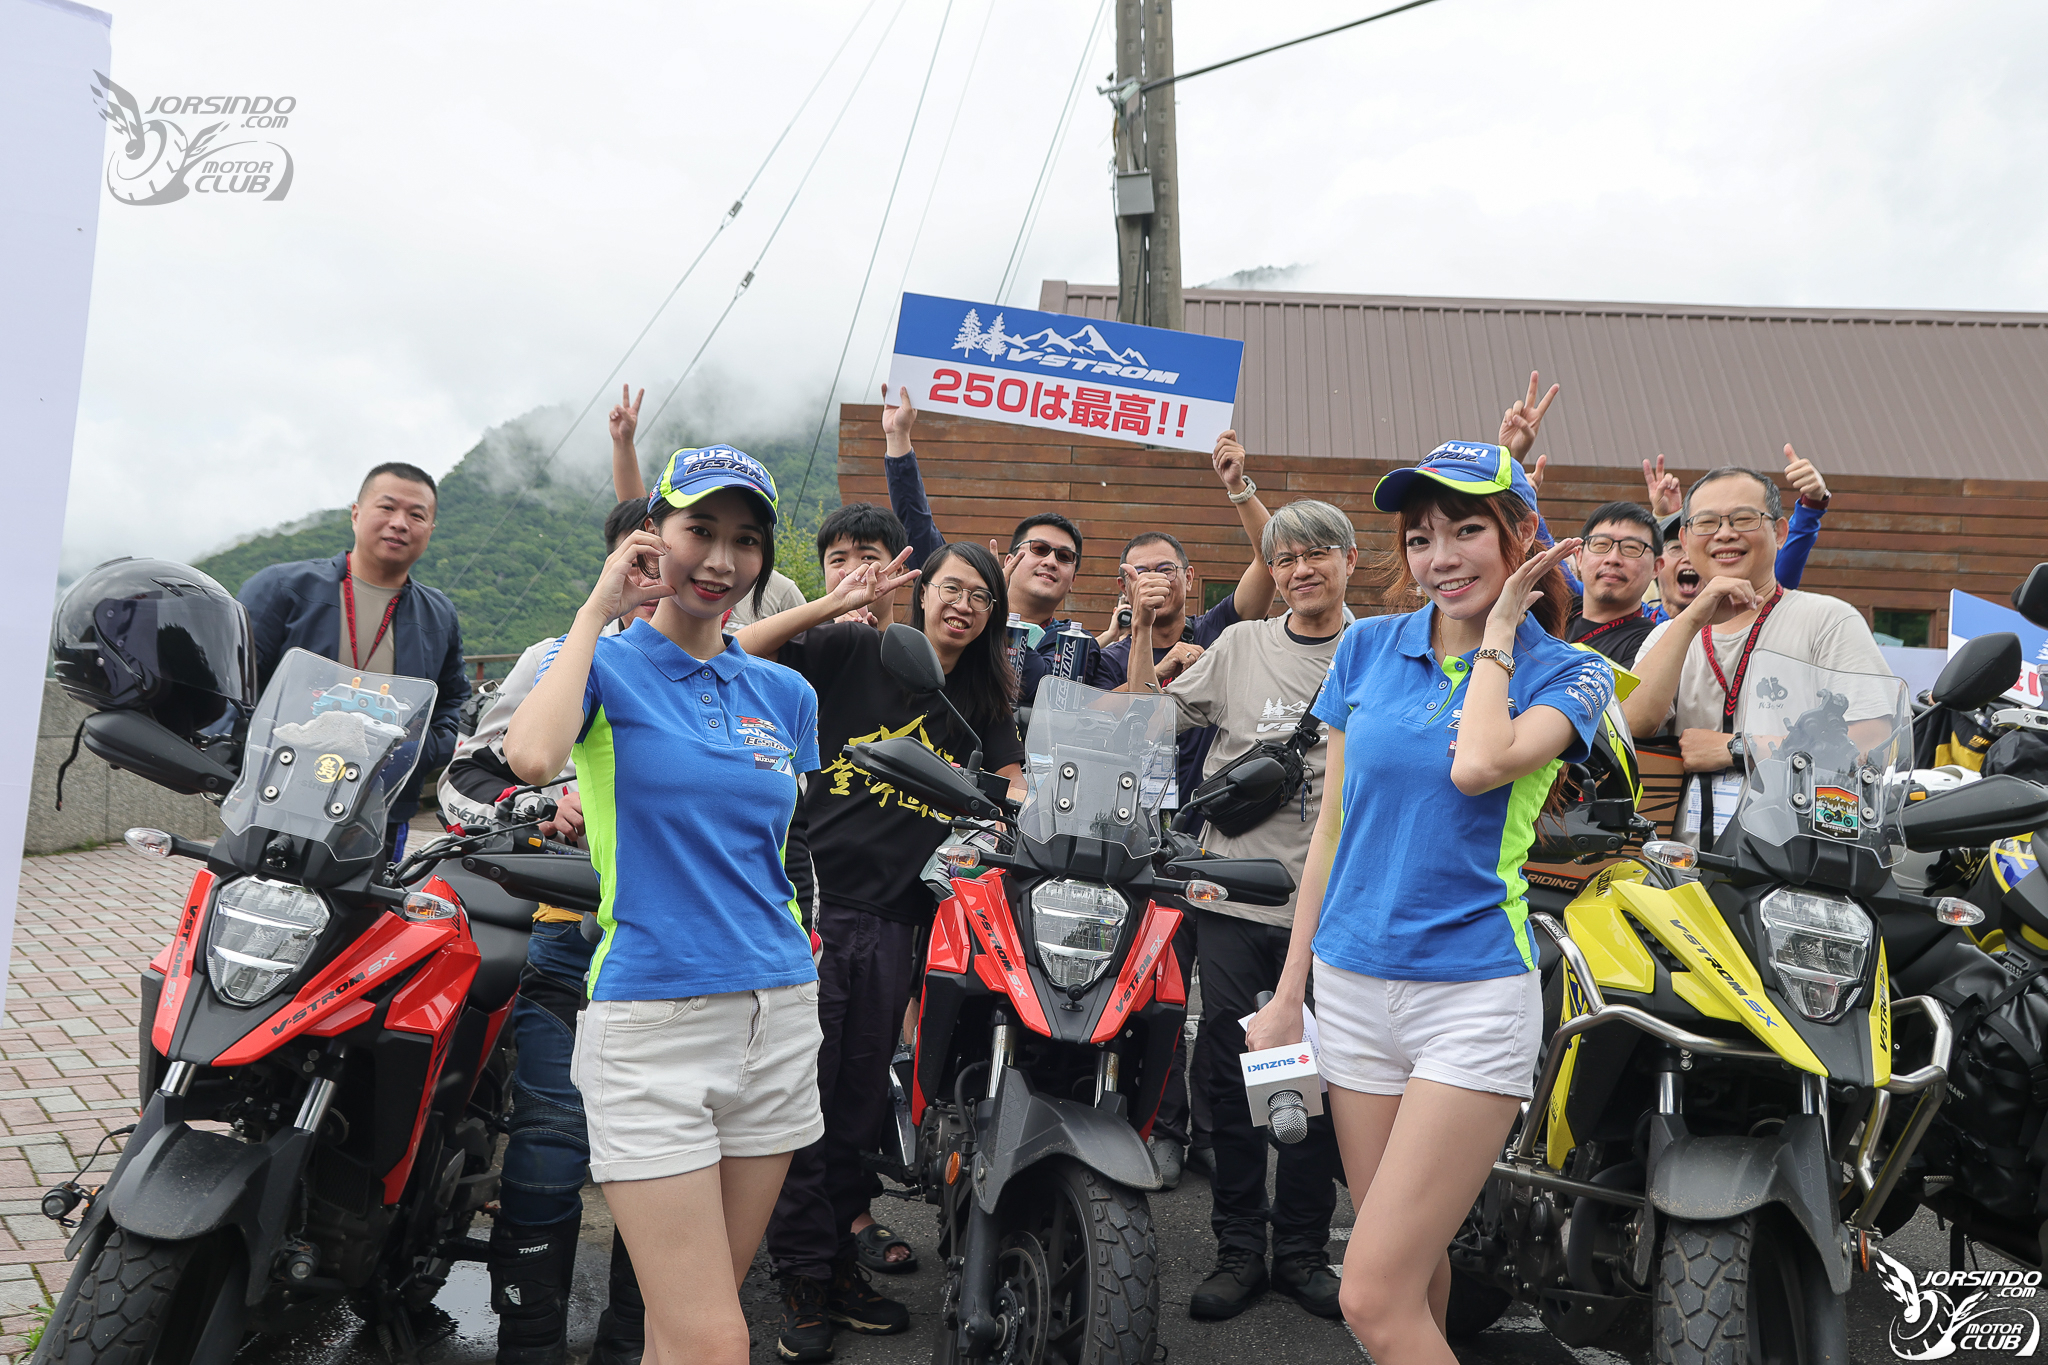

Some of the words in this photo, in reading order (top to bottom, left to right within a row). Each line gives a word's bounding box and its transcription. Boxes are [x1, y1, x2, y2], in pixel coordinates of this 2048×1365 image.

[1006, 347, 1180, 385] V-STROM
[683, 449, 766, 480] SUZUKI
[1744, 624, 1762, 654] FESTIVAL
[1526, 873, 1579, 891] RIDING
[170, 905, 199, 979] V-STROM
[973, 908, 1014, 972] V-STROM
[1008, 973, 1029, 999] SX
[1115, 954, 1153, 1014] V-STROM
[1150, 934, 1164, 959] SX
[1669, 918, 1751, 997] V-STROM
[1742, 996, 1780, 1029] SX
[163, 981, 176, 1009] SX
[270, 971, 366, 1036] V-STROM
[367, 950, 398, 976] SX
[1247, 1057, 1296, 1073] SUZUKI
[518, 1243, 549, 1255] THOR
